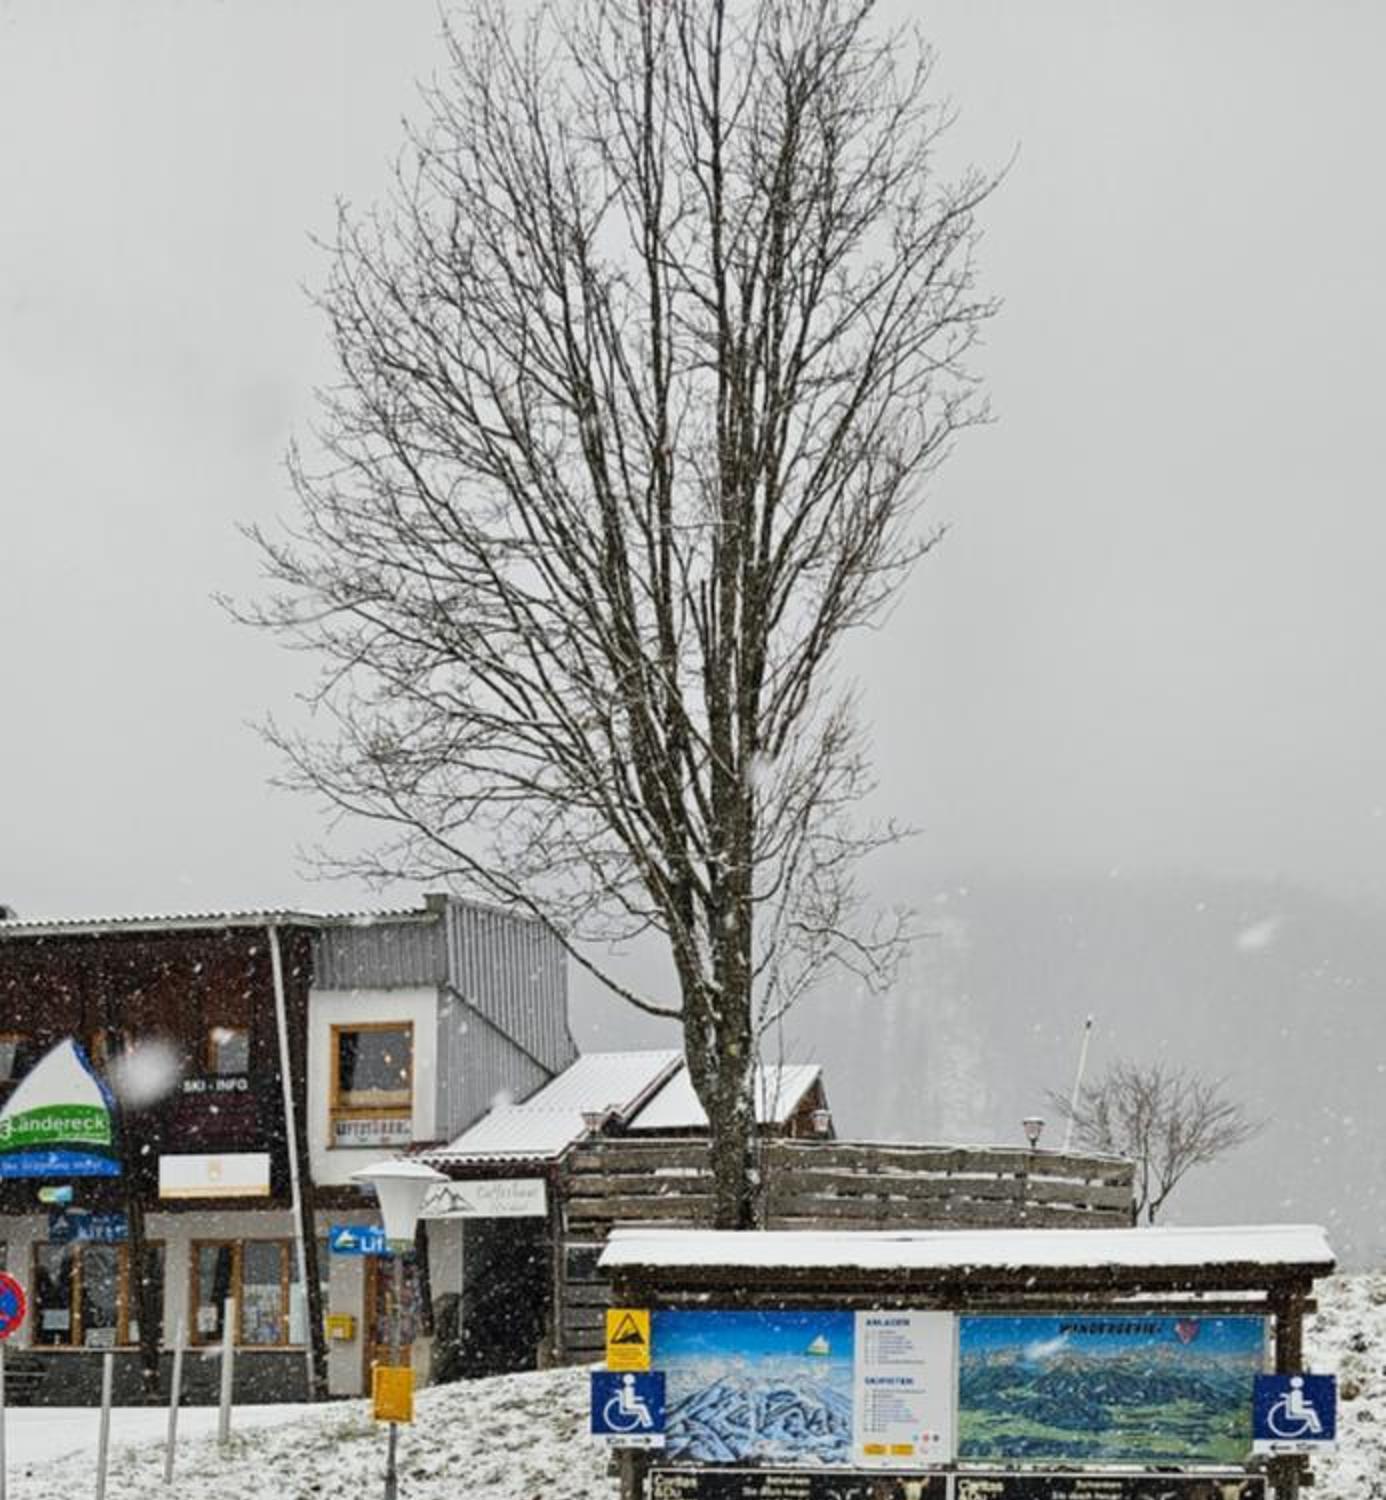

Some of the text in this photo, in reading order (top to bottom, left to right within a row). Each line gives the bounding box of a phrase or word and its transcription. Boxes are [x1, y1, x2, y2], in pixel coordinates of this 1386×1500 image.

[183, 1080, 206, 1092] SKI
[216, 1078, 249, 1091] INFO
[866, 1318, 911, 1327] ANLAGEN
